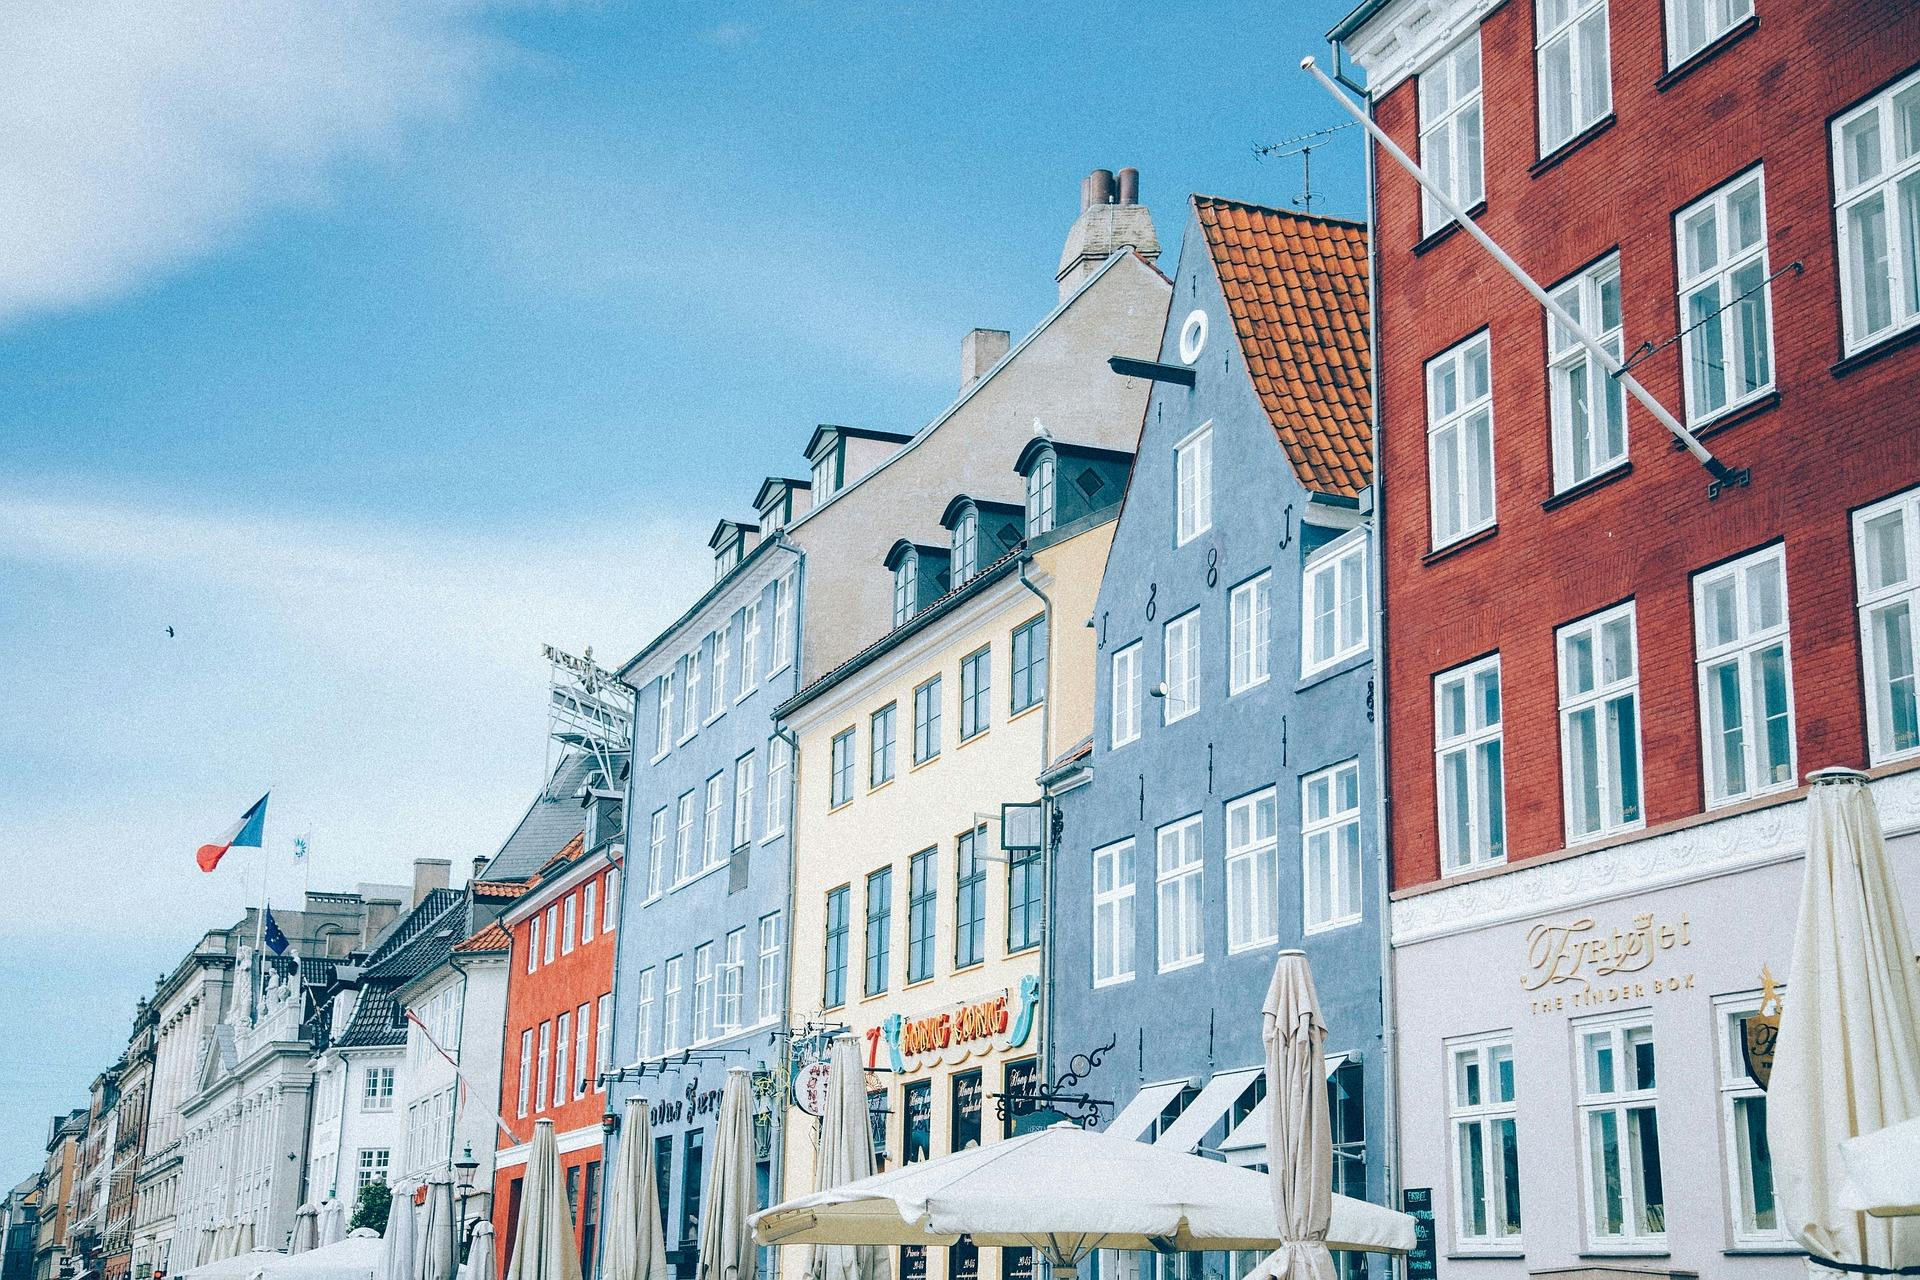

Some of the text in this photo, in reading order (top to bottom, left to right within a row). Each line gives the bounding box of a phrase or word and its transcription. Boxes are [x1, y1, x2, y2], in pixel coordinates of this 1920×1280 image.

[1529, 973, 1695, 1015] THE TINDER BOX
[953, 996, 1008, 1046] KONG
